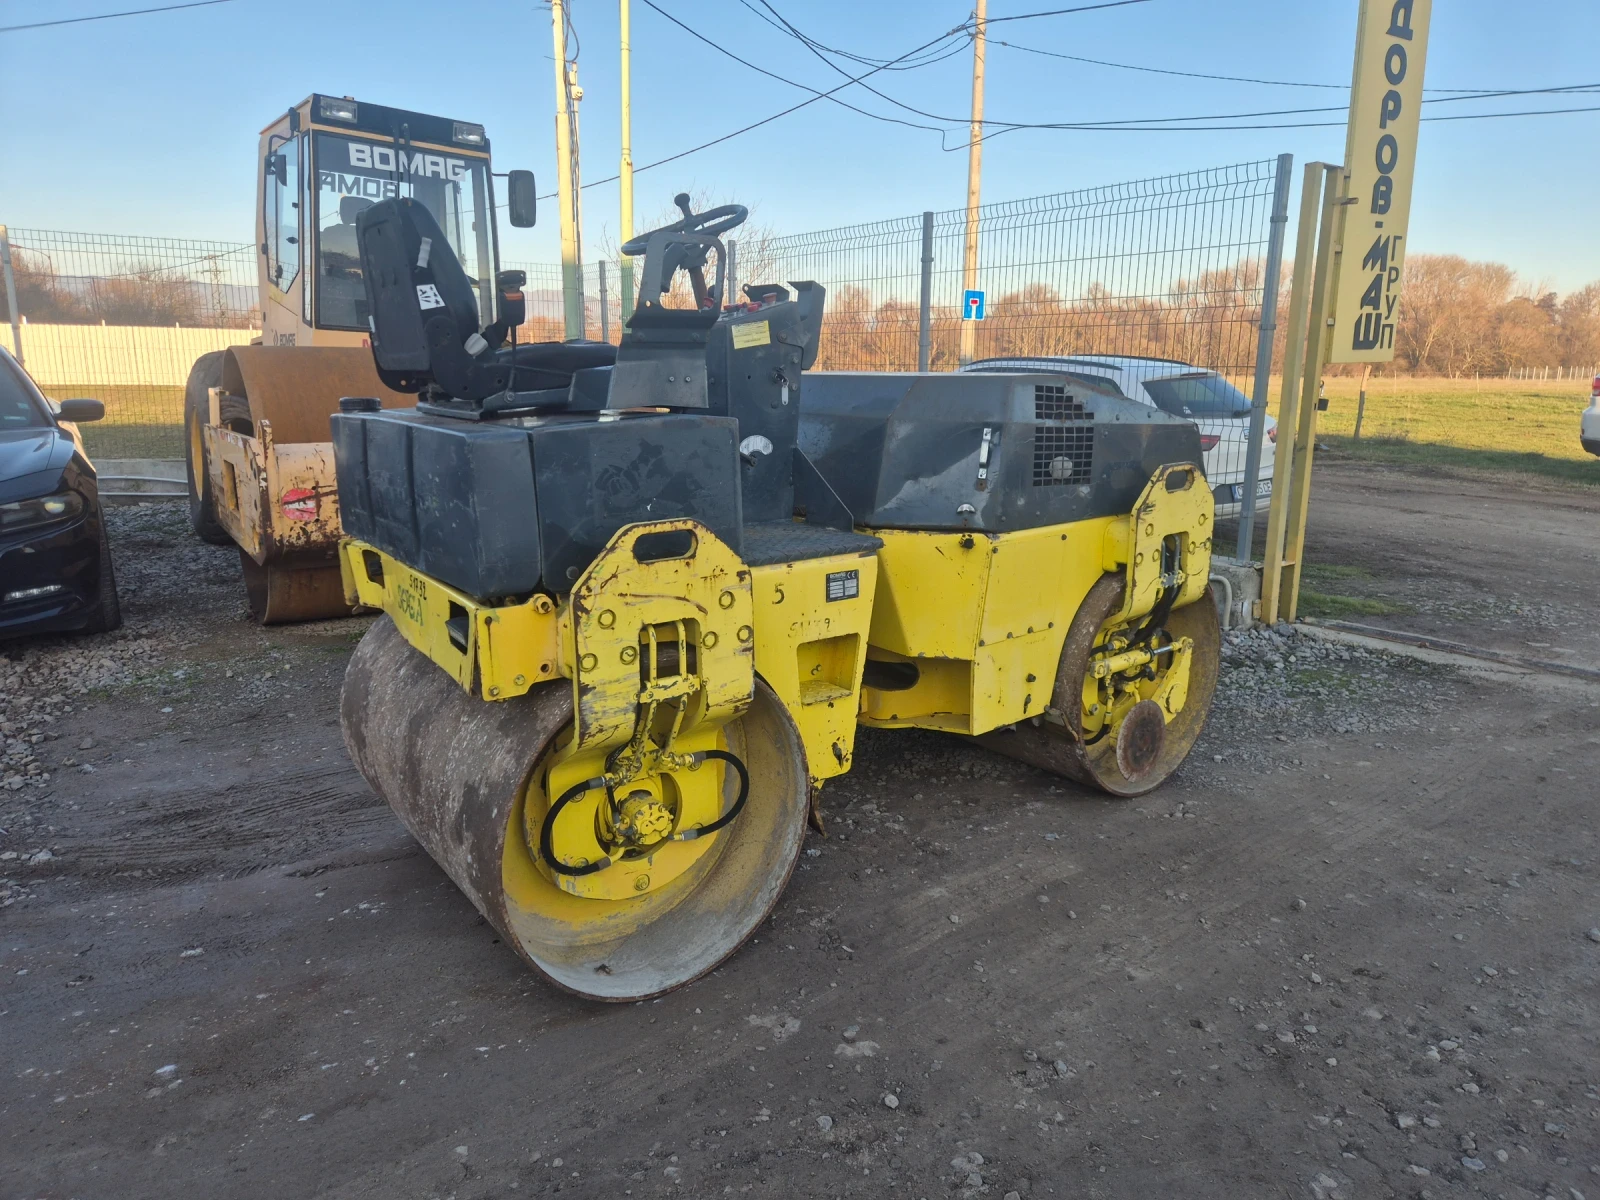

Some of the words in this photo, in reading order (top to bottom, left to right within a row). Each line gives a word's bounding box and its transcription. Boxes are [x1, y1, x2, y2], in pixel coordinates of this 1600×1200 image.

[348, 143, 466, 181] BOMAG
[1380, 235, 1402, 349] ГРУП
[279, 333, 295, 346] BOMAG
